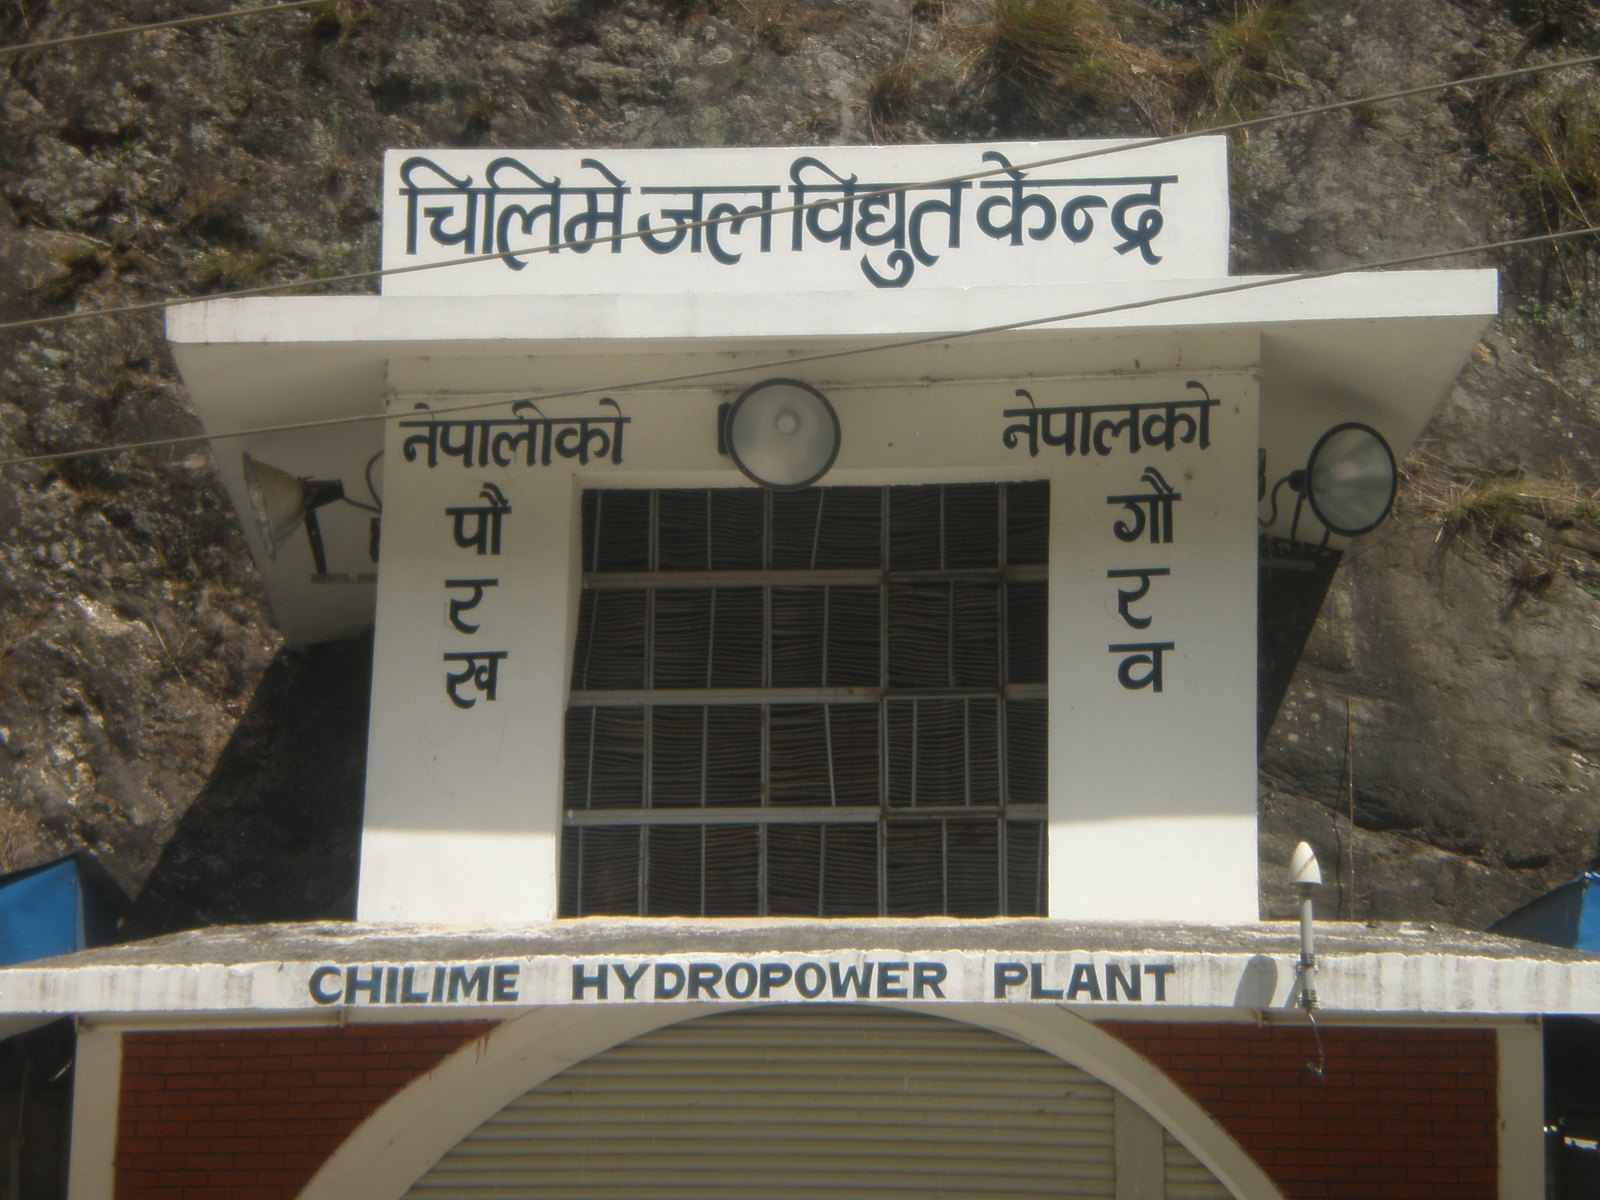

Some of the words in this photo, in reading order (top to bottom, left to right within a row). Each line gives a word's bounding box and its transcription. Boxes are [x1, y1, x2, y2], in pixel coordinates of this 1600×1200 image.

[399, 156, 631, 271] चिलिमे
[637, 184, 781, 265] जल
[976, 151, 1178, 265] केन्द्र
[399, 397, 631, 469] नेपालीको
[1003, 380, 1221, 458] नेपालको
[308, 963, 520, 1005] CHILIME
[571, 961, 948, 1001] HYDROPOWER
[993, 961, 1176, 1002] PLANT
